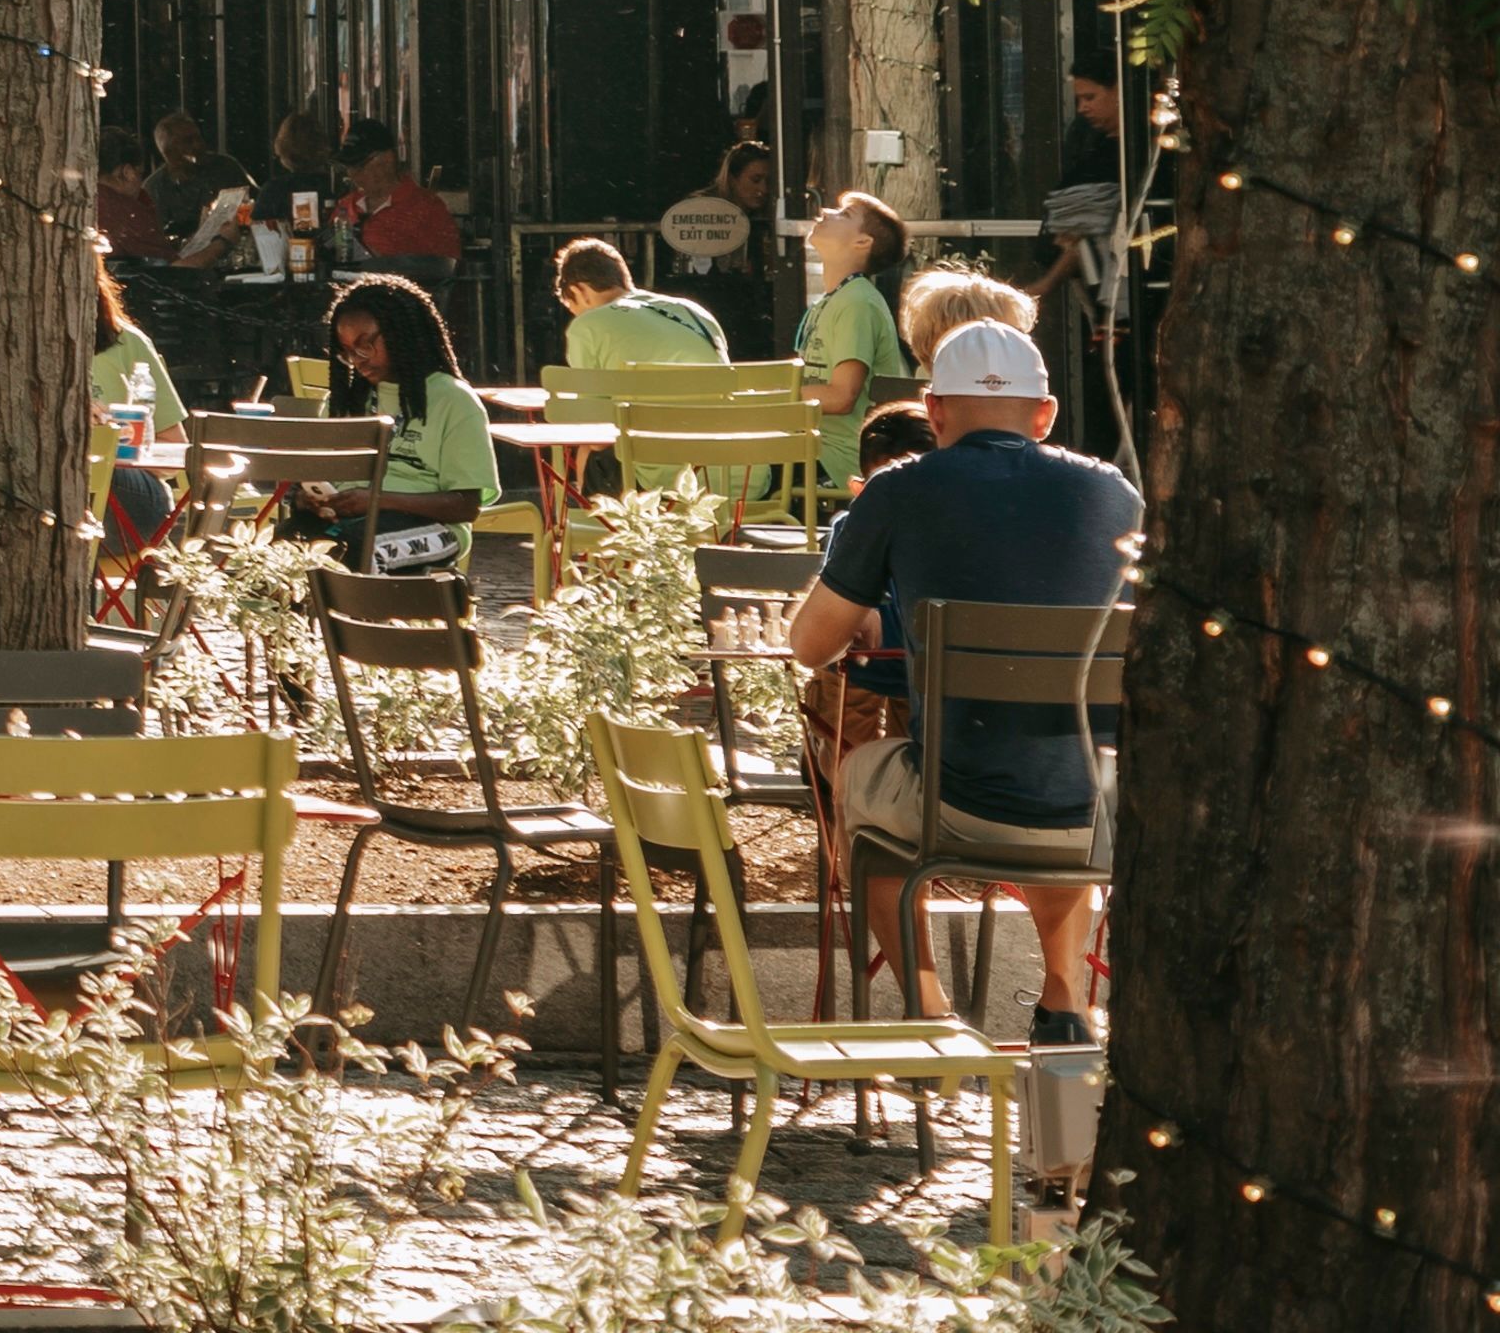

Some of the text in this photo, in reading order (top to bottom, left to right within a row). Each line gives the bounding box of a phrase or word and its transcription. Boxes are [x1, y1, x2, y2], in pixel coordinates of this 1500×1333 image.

[672, 214, 738, 225] EMERGENCY
[679, 229, 731, 241] EXIT ONLY
